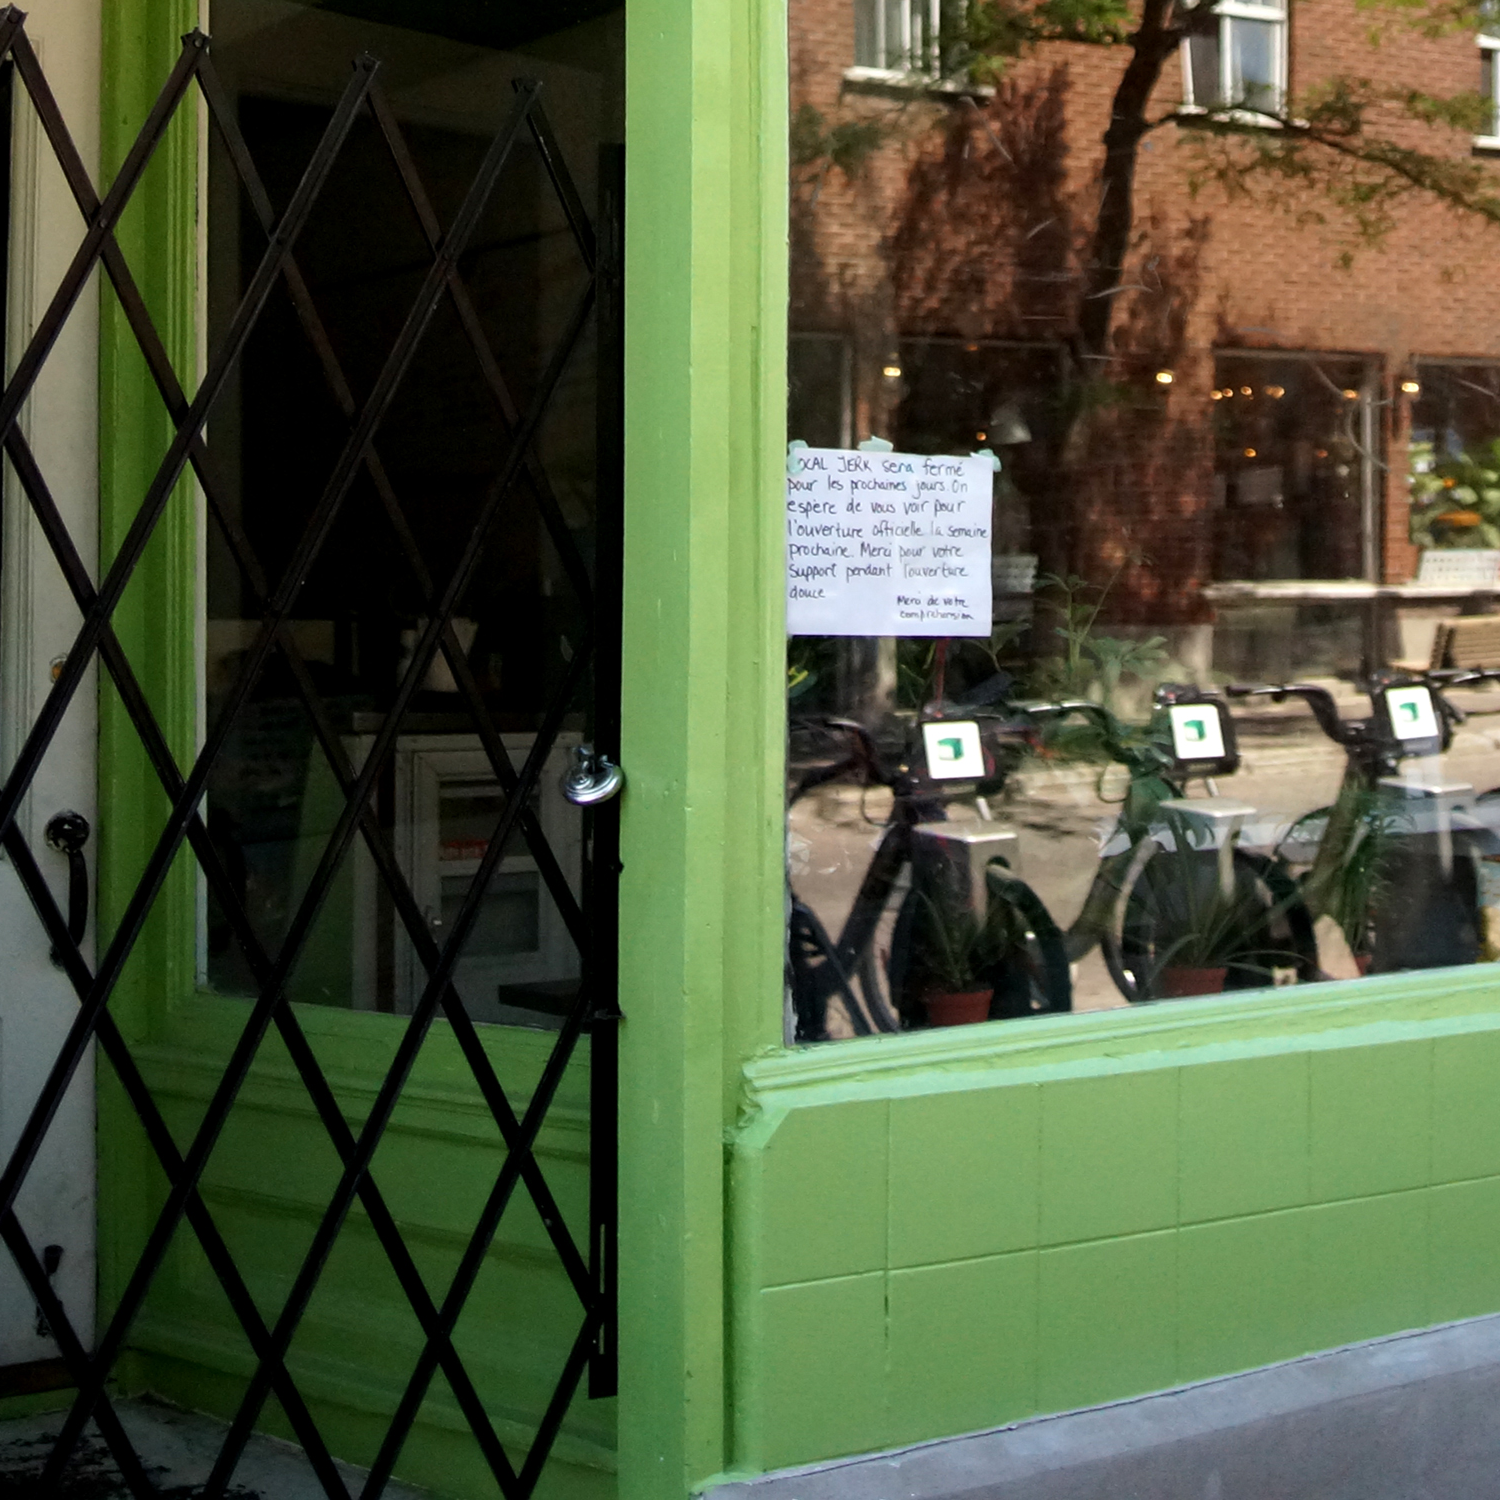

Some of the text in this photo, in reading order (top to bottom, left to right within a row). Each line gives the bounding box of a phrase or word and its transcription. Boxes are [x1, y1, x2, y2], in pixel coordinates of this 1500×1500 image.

[837, 456, 873, 473] JERK
[922, 457, 965, 477] fermé
[787, 478, 818, 495] pour
[828, 476, 844, 491] les
[851, 477, 907, 493] prochaines
[846, 499, 862, 513] de
[871, 501, 896, 514] vous
[903, 500, 926, 516] voir
[934, 500, 966, 517] pour
[788, 518, 863, 538] l'ouverture
[872, 520, 924, 538] officielle
[930, 521, 943, 537] la
[860, 542, 892, 558] Merci
[899, 545, 926, 563] pour
[932, 543, 964, 558] votre
[846, 564, 893, 583] pendant
[789, 585, 826, 600] douce
